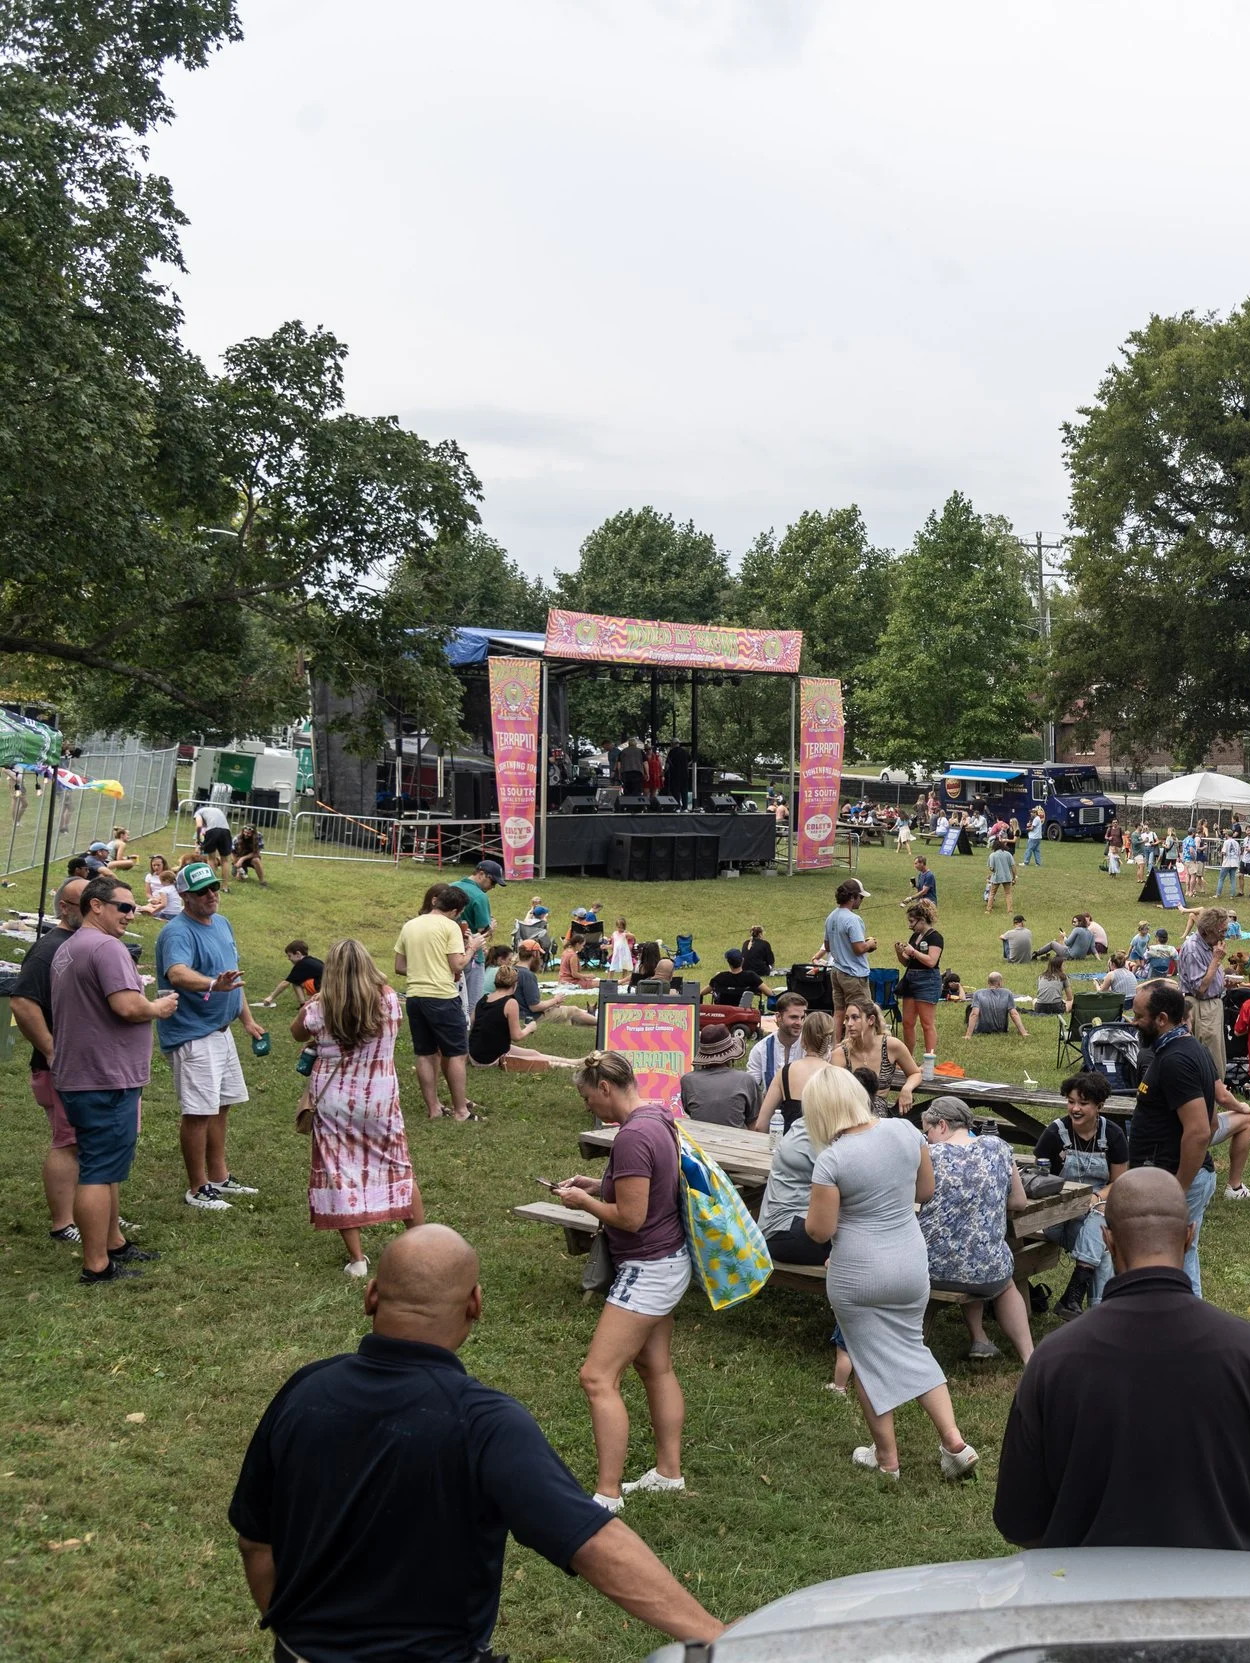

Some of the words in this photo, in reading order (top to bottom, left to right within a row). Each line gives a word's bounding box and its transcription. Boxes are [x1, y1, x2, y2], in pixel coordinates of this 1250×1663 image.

[496, 731, 536, 752] TERRAPIN
[804, 742, 840, 759] TERRAPIN
[496, 761, 526, 773] LIGHTNING
[802, 767, 832, 778] LIGHTNING
[500, 787, 506, 796] 12
[507, 787, 536, 797] SOUTH
[804, 790, 812, 798] 12
[815, 789, 837, 797] SOUTH
[806, 822, 832, 831] EDLEY'S
